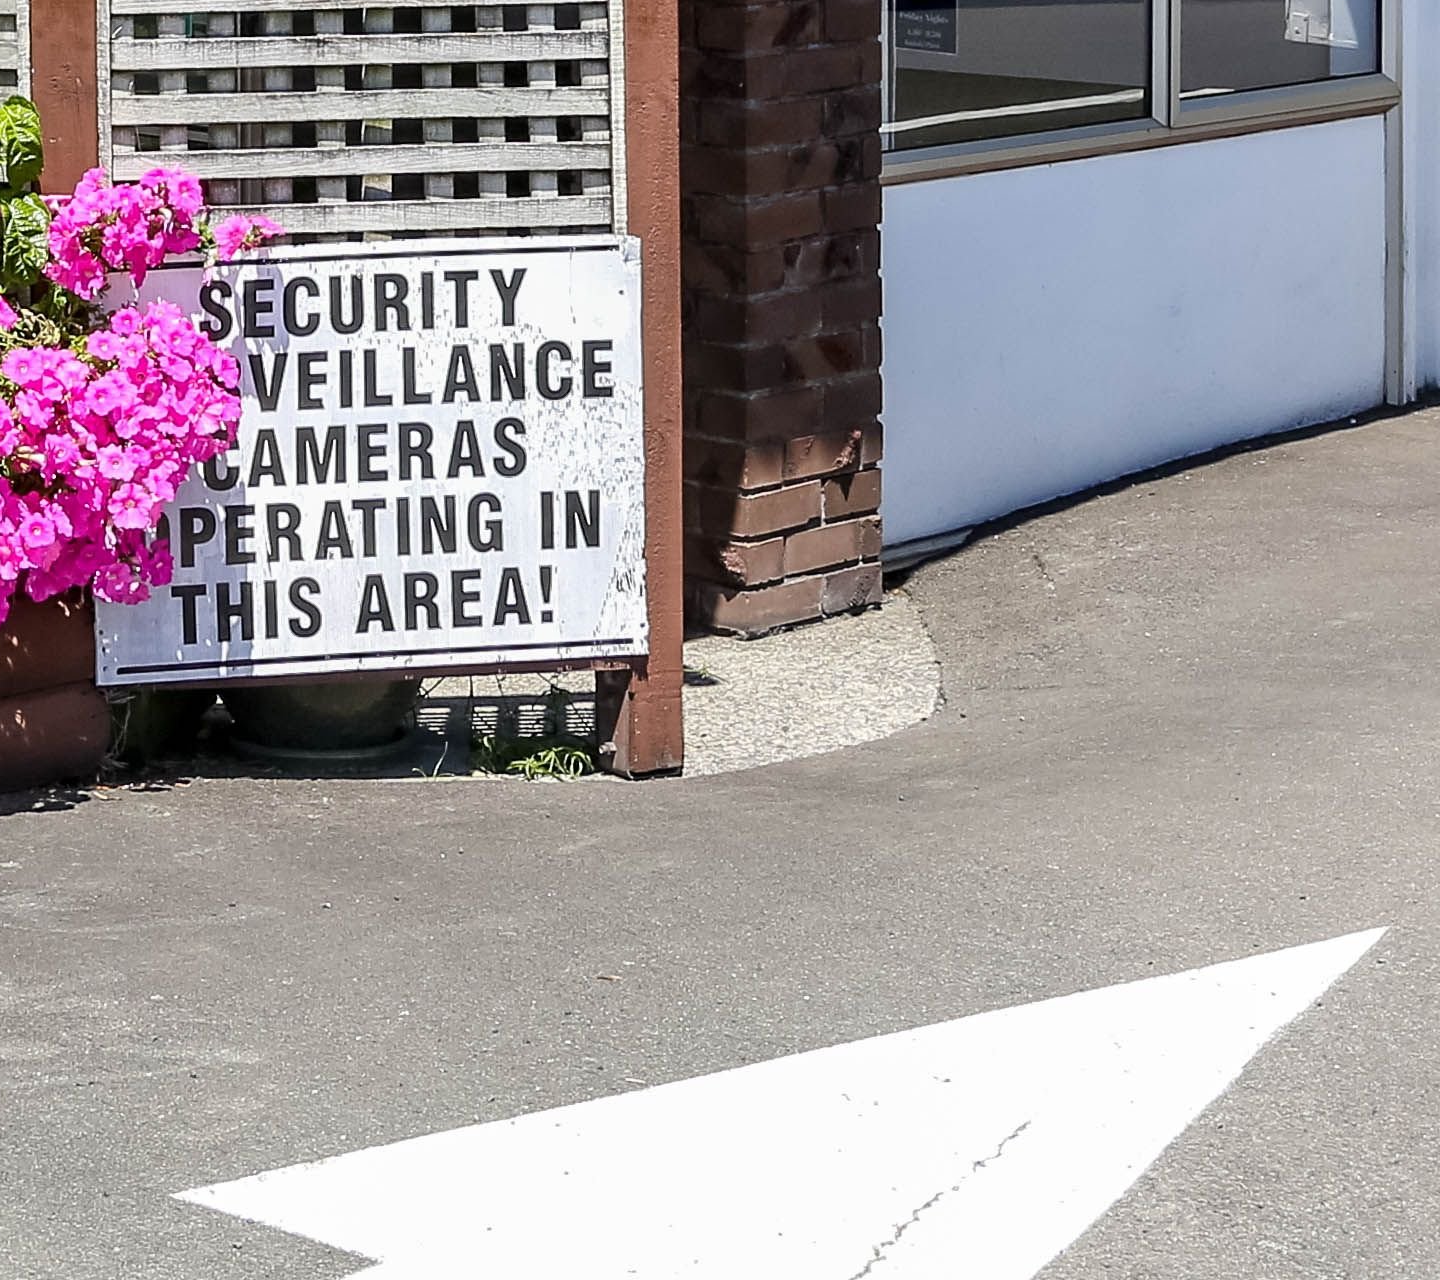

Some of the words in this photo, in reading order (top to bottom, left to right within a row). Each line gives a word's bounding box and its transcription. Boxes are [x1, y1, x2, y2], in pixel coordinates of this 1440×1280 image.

[199, 268, 527, 341] SECURITY
[247, 340, 614, 413] VEILLANCE
[155, 492, 504, 569] PERATING
[540, 489, 601, 550] IN
[170, 576, 321, 646] THIS
[355, 564, 554, 634] AREA!
